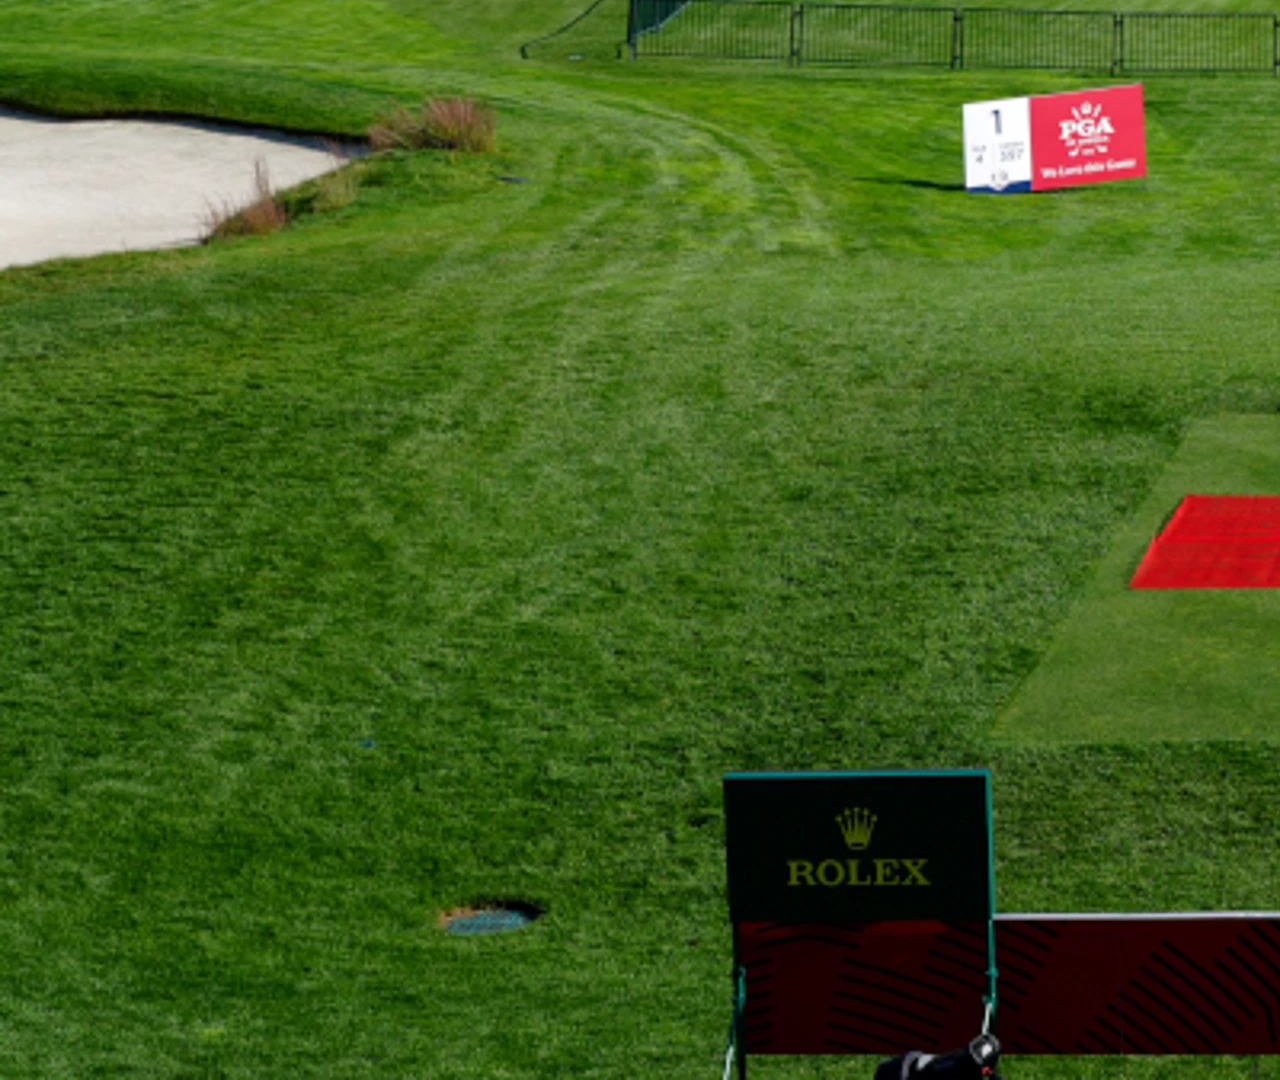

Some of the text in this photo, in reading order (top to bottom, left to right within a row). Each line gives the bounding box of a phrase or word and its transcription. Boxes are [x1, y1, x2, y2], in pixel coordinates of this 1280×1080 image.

[991, 109, 1003, 135] 1
[1058, 116, 1115, 140] PGA
[787, 858, 931, 886] ROLEX
